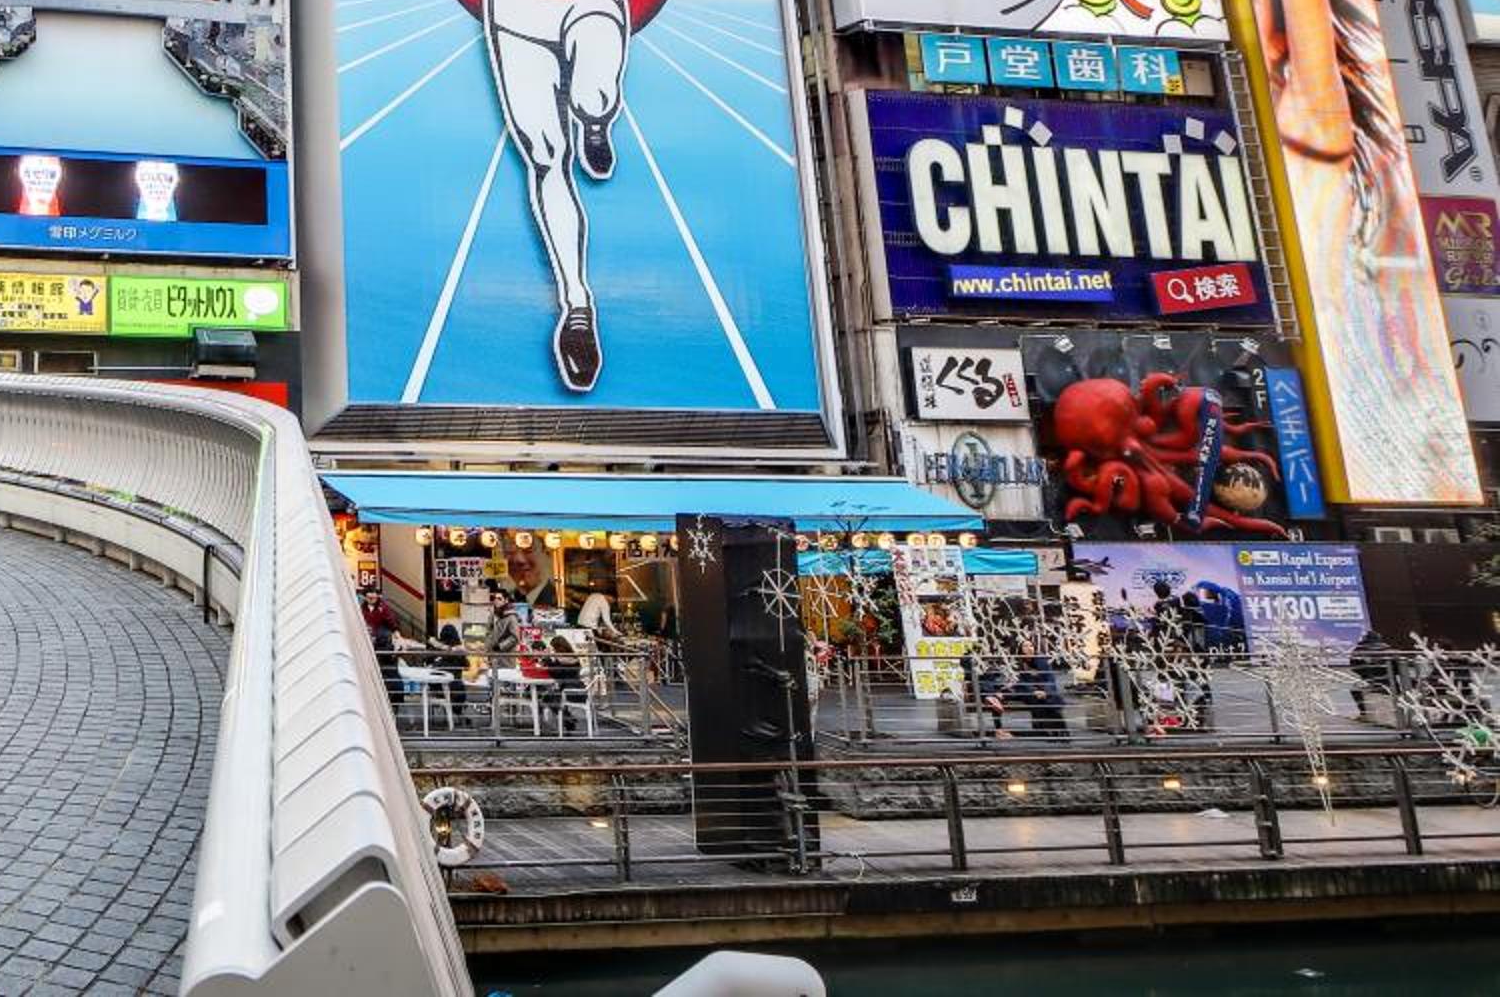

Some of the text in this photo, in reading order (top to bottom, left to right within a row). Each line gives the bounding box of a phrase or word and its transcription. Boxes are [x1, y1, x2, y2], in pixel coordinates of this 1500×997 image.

[936, 41, 1168, 86] 戸堂歯科
[907, 111, 1257, 261] CHINTAI
[49, 225, 137, 241] 雪印メグミルク
[167, 284, 237, 319] ピタットハウス
[1194, 273, 1241, 301] 検索
[936, 356, 1004, 409] くくる
[1281, 551, 1313, 569] Rapid
[1315, 552, 1354, 569] Express
[1256, 571, 1292, 586] Kansai
[1320, 572, 1357, 590] Airport
